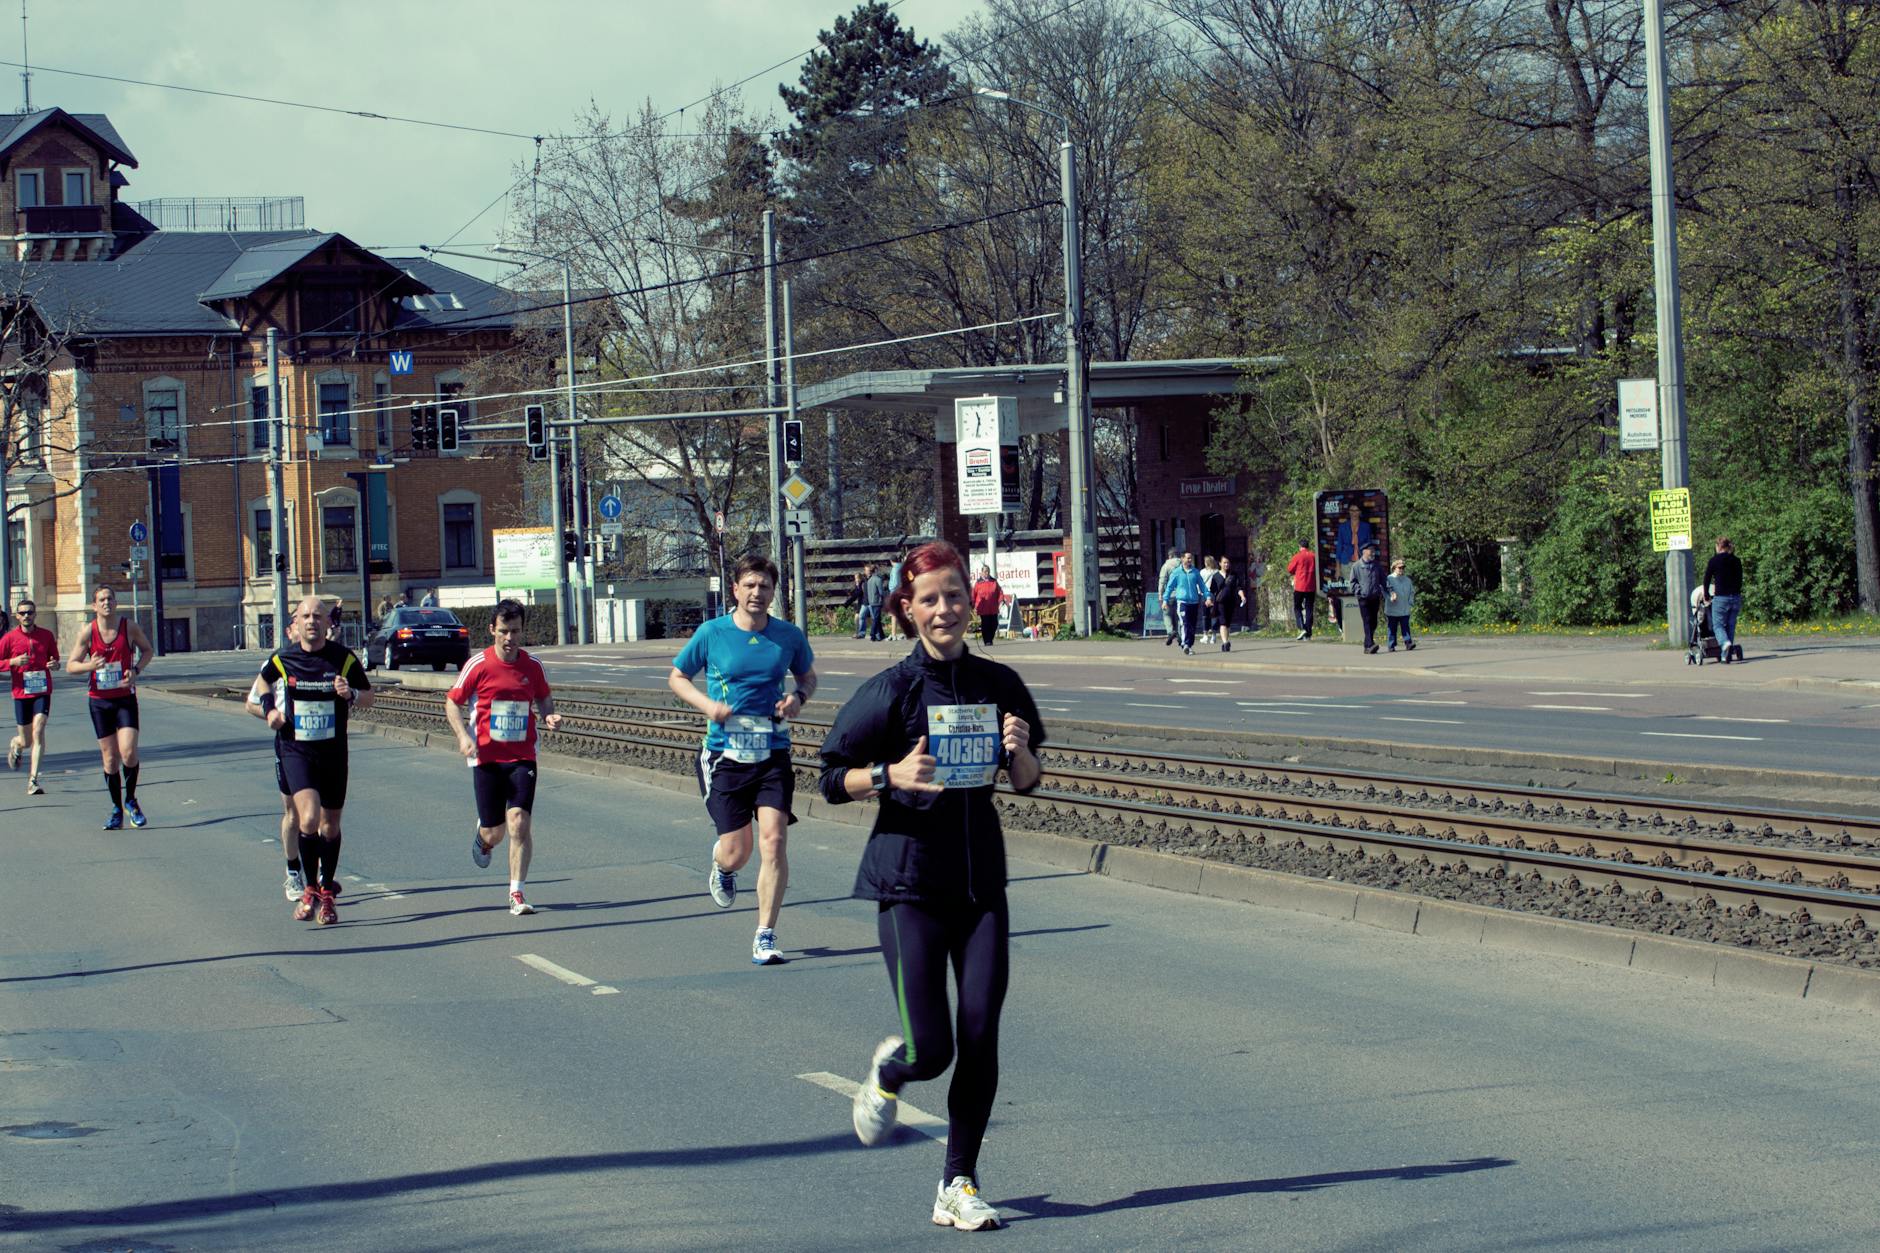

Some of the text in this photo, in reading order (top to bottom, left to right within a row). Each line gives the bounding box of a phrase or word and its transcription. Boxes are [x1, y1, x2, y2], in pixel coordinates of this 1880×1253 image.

[392, 354, 411, 371] W
[1654, 507, 1688, 516] MARKT
[1659, 500, 1684, 509] FLOH
[1654, 516, 1689, 524] LEIPZIG
[300, 715, 330, 729] 40317
[495, 716, 524, 730] 40501
[728, 733, 768, 749] 40266
[936, 736, 994, 765] 40366
